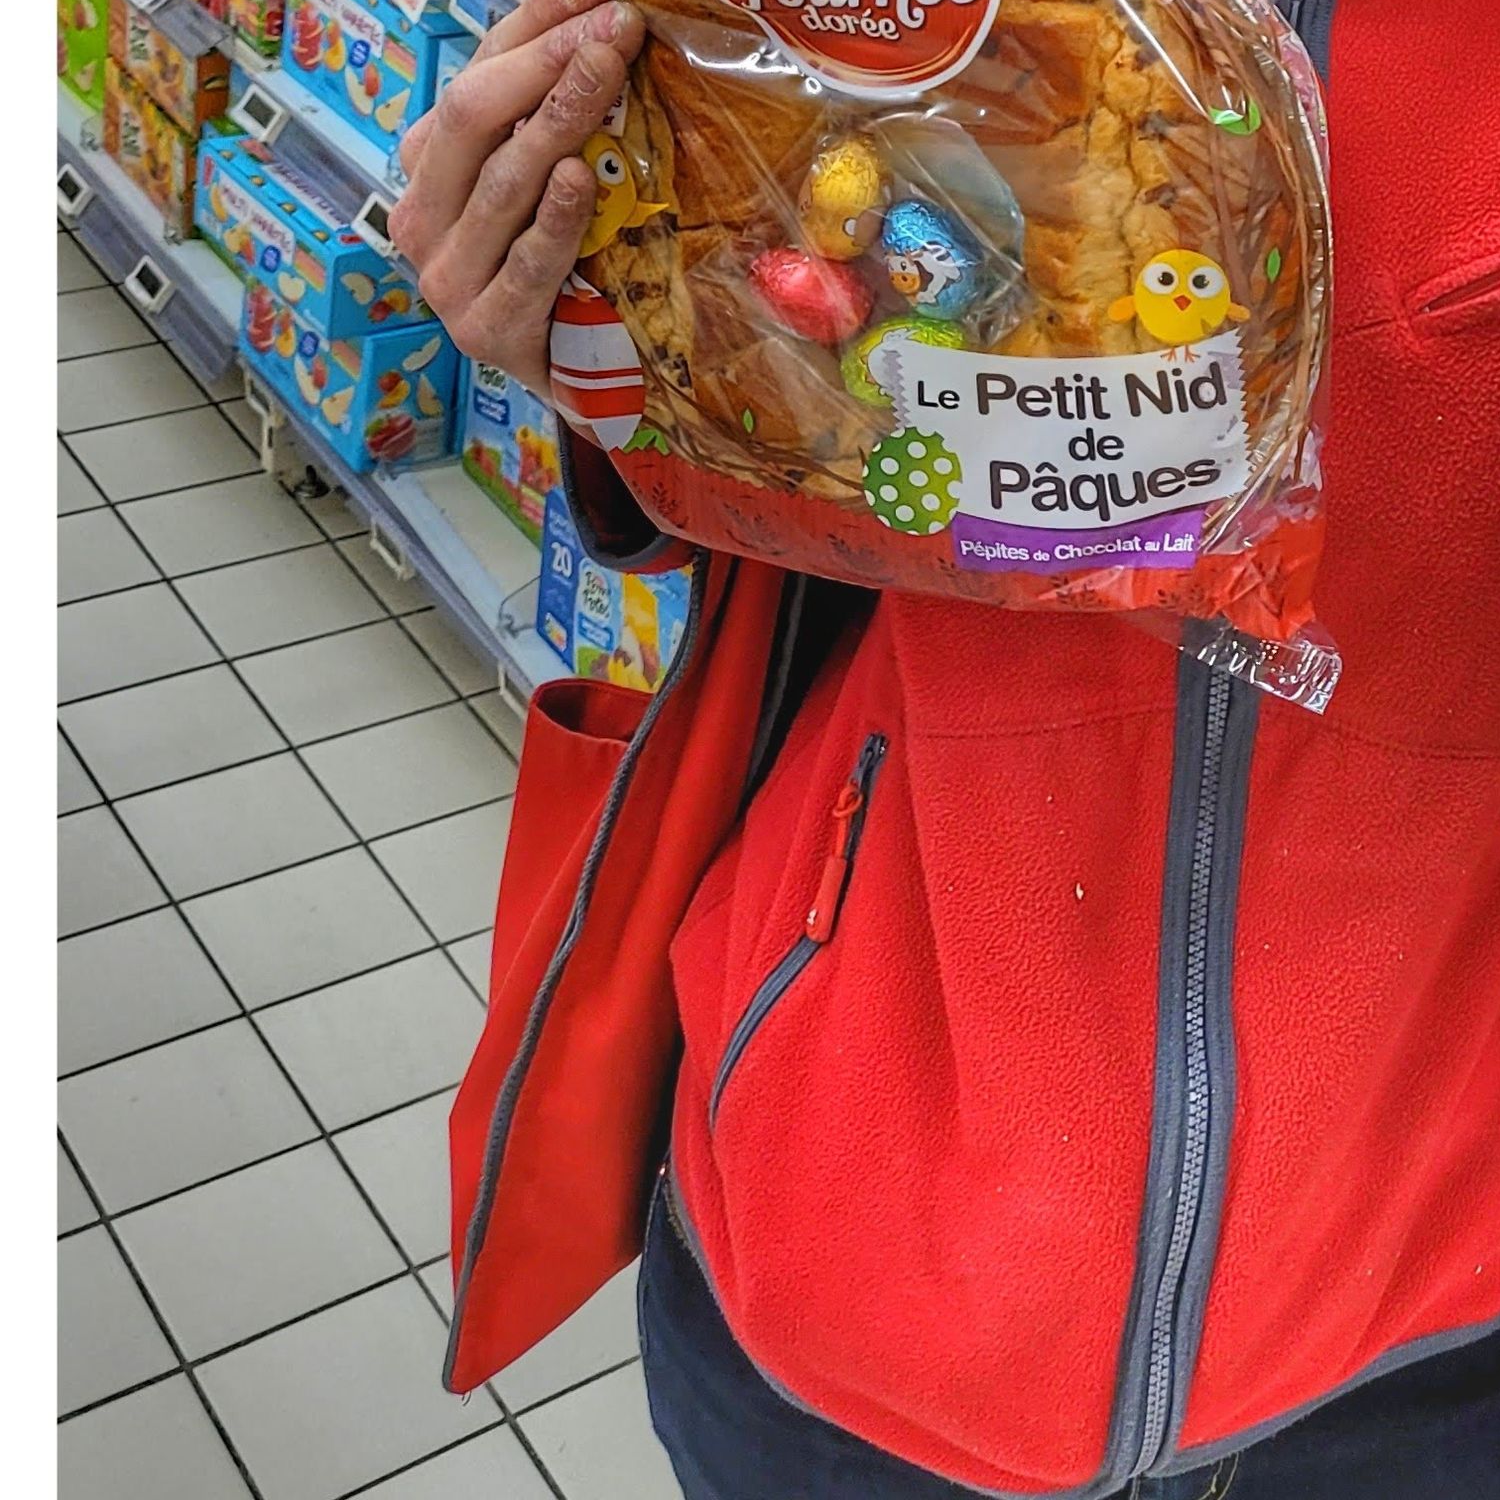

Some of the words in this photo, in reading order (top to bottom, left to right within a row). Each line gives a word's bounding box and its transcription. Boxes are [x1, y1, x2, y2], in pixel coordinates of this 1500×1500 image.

[800, 4, 900, 41] dorée
[917, 380, 961, 411] Le
[975, 372, 1111, 421] Petit
[1124, 360, 1228, 418] Nid
[1067, 427, 1125, 462] de
[989, 457, 1221, 522] Pâques
[960, 539, 1030, 562] Pépites
[1032, 548, 1050, 562] de
[1053, 535, 1142, 561] Chocolat
[1144, 539, 1161, 552] au
[1162, 532, 1195, 553] Lait
